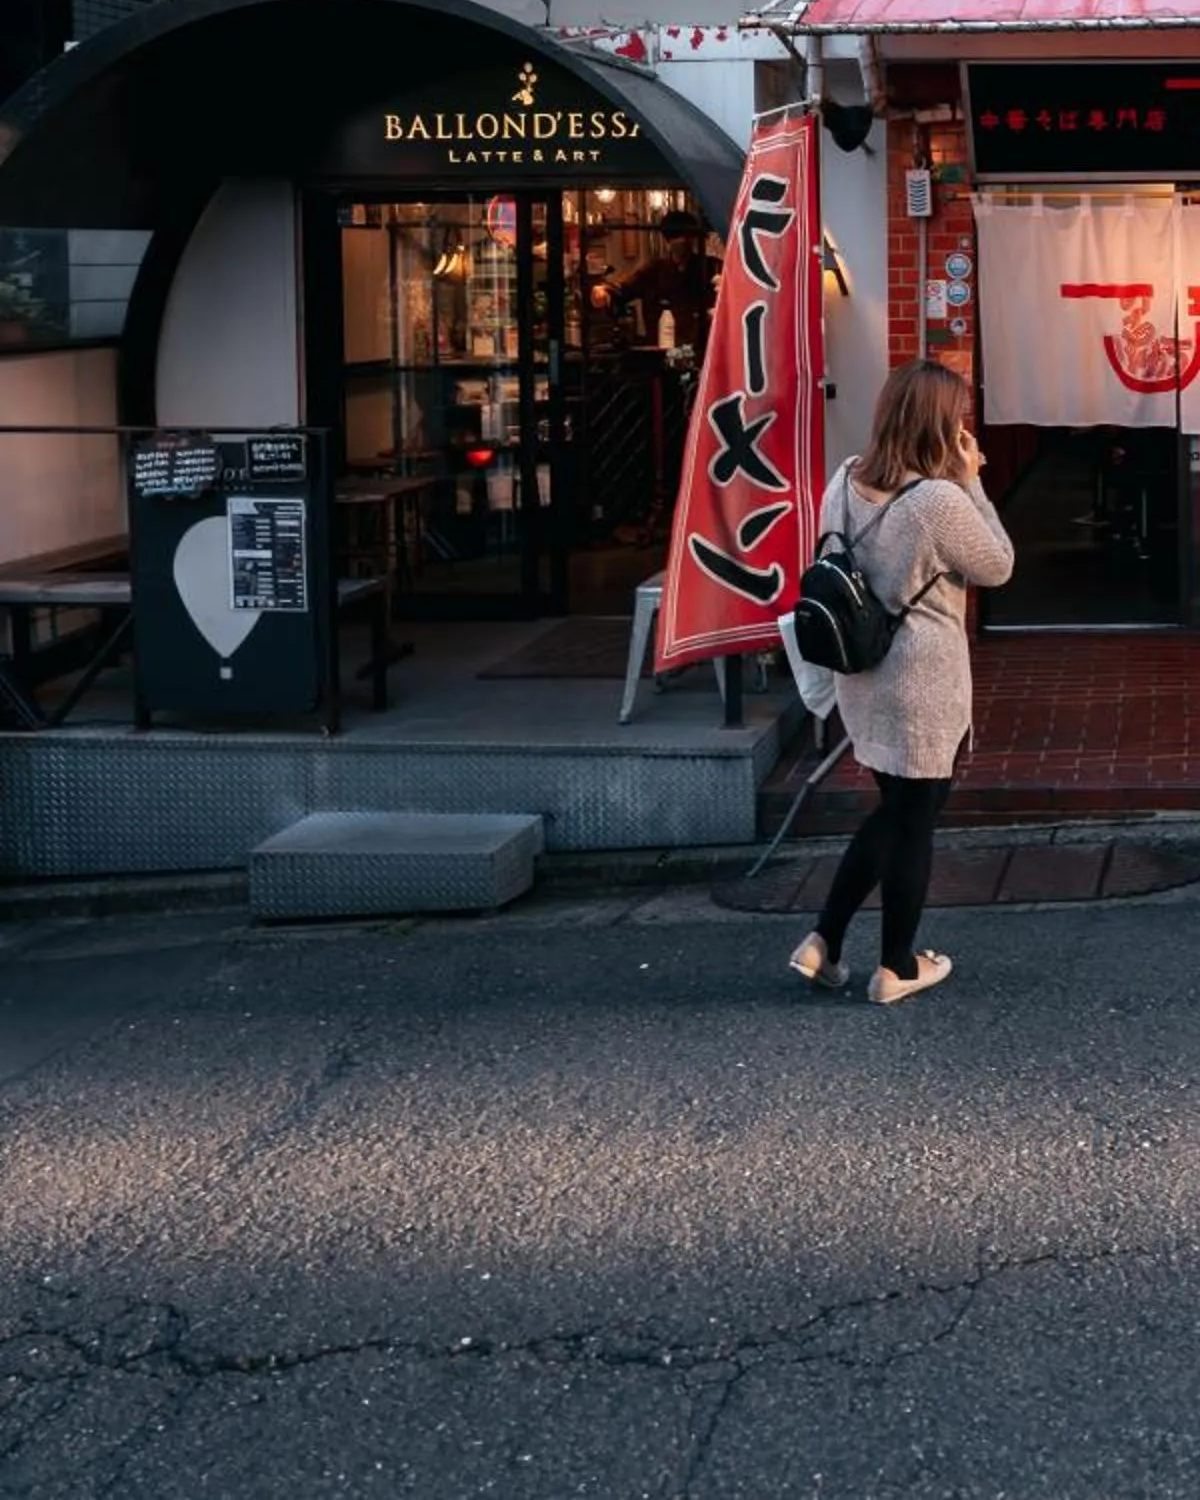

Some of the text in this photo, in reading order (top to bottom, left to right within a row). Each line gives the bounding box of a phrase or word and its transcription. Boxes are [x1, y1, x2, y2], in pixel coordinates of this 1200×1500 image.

[449, 150, 601, 163] LATTE & ART
